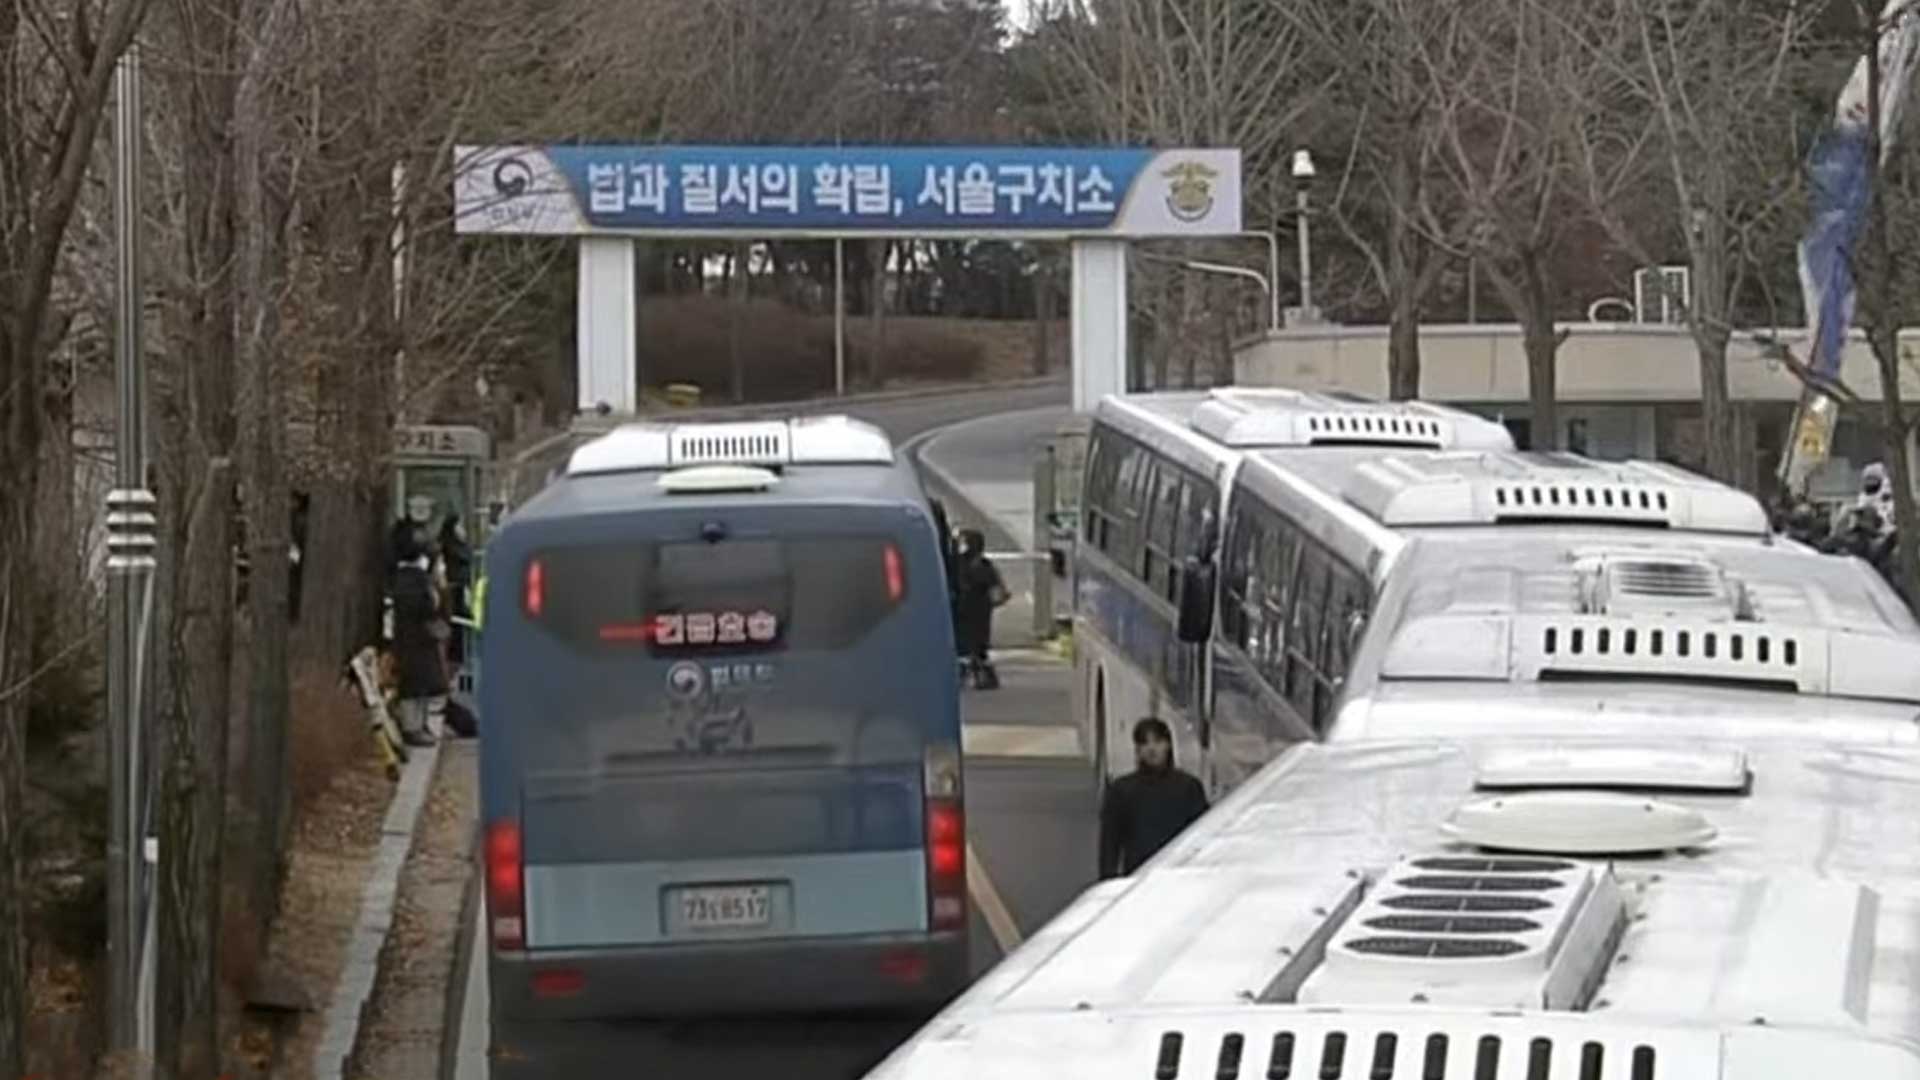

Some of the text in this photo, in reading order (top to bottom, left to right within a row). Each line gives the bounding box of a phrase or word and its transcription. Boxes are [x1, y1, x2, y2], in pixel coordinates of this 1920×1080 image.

[588, 162, 1115, 217] 법과 질서의 확립, 서울구치소
